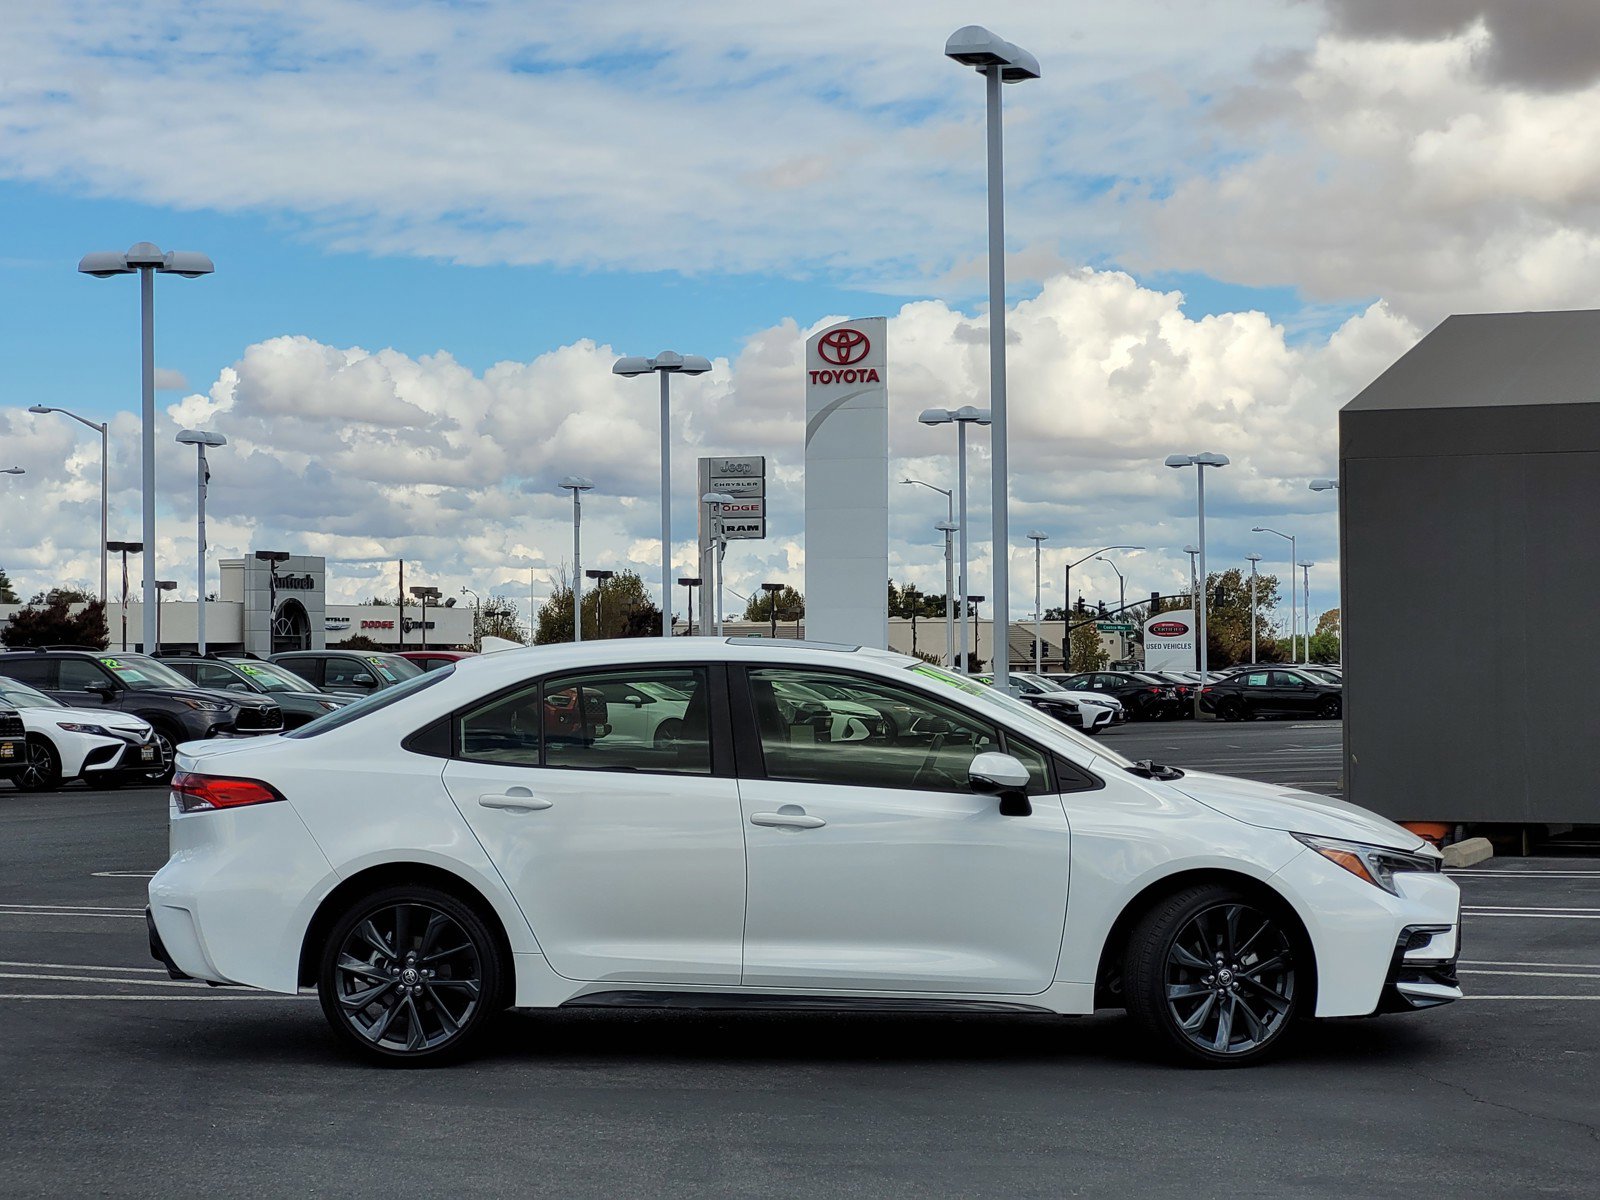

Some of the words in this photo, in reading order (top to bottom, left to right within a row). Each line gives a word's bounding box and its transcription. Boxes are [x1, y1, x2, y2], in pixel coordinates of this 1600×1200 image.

[809, 368, 880, 385] TOYOTA
[720, 460, 751, 474] Jeep
[726, 524, 759, 532] RAM
[360, 620, 395, 629] DODGE
